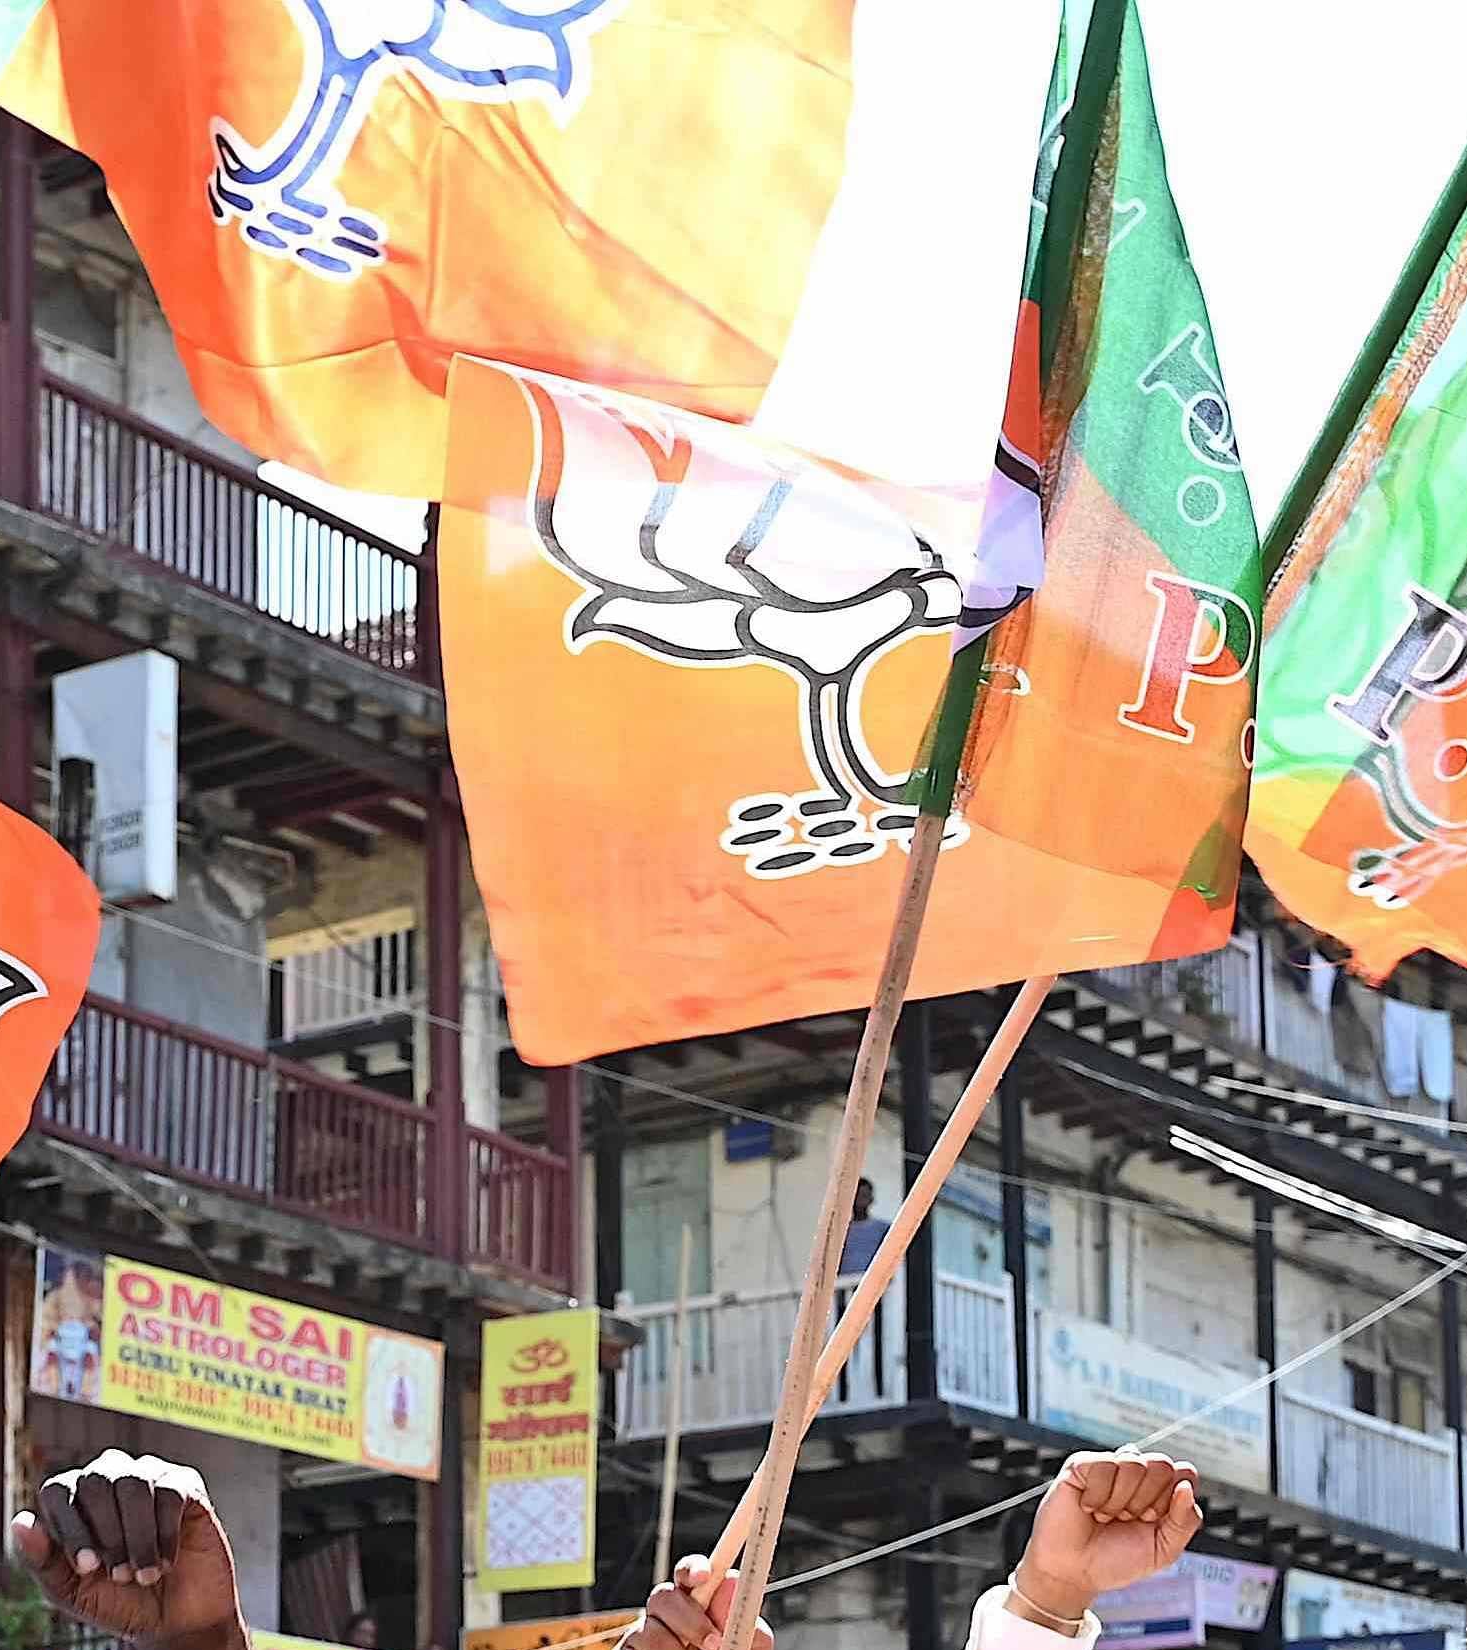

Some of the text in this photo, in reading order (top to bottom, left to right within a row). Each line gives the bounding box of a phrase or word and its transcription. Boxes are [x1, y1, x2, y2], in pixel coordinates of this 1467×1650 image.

[116, 1272, 356, 1363] OM SAI
[119, 1312, 349, 1391] ASTROLOGER
